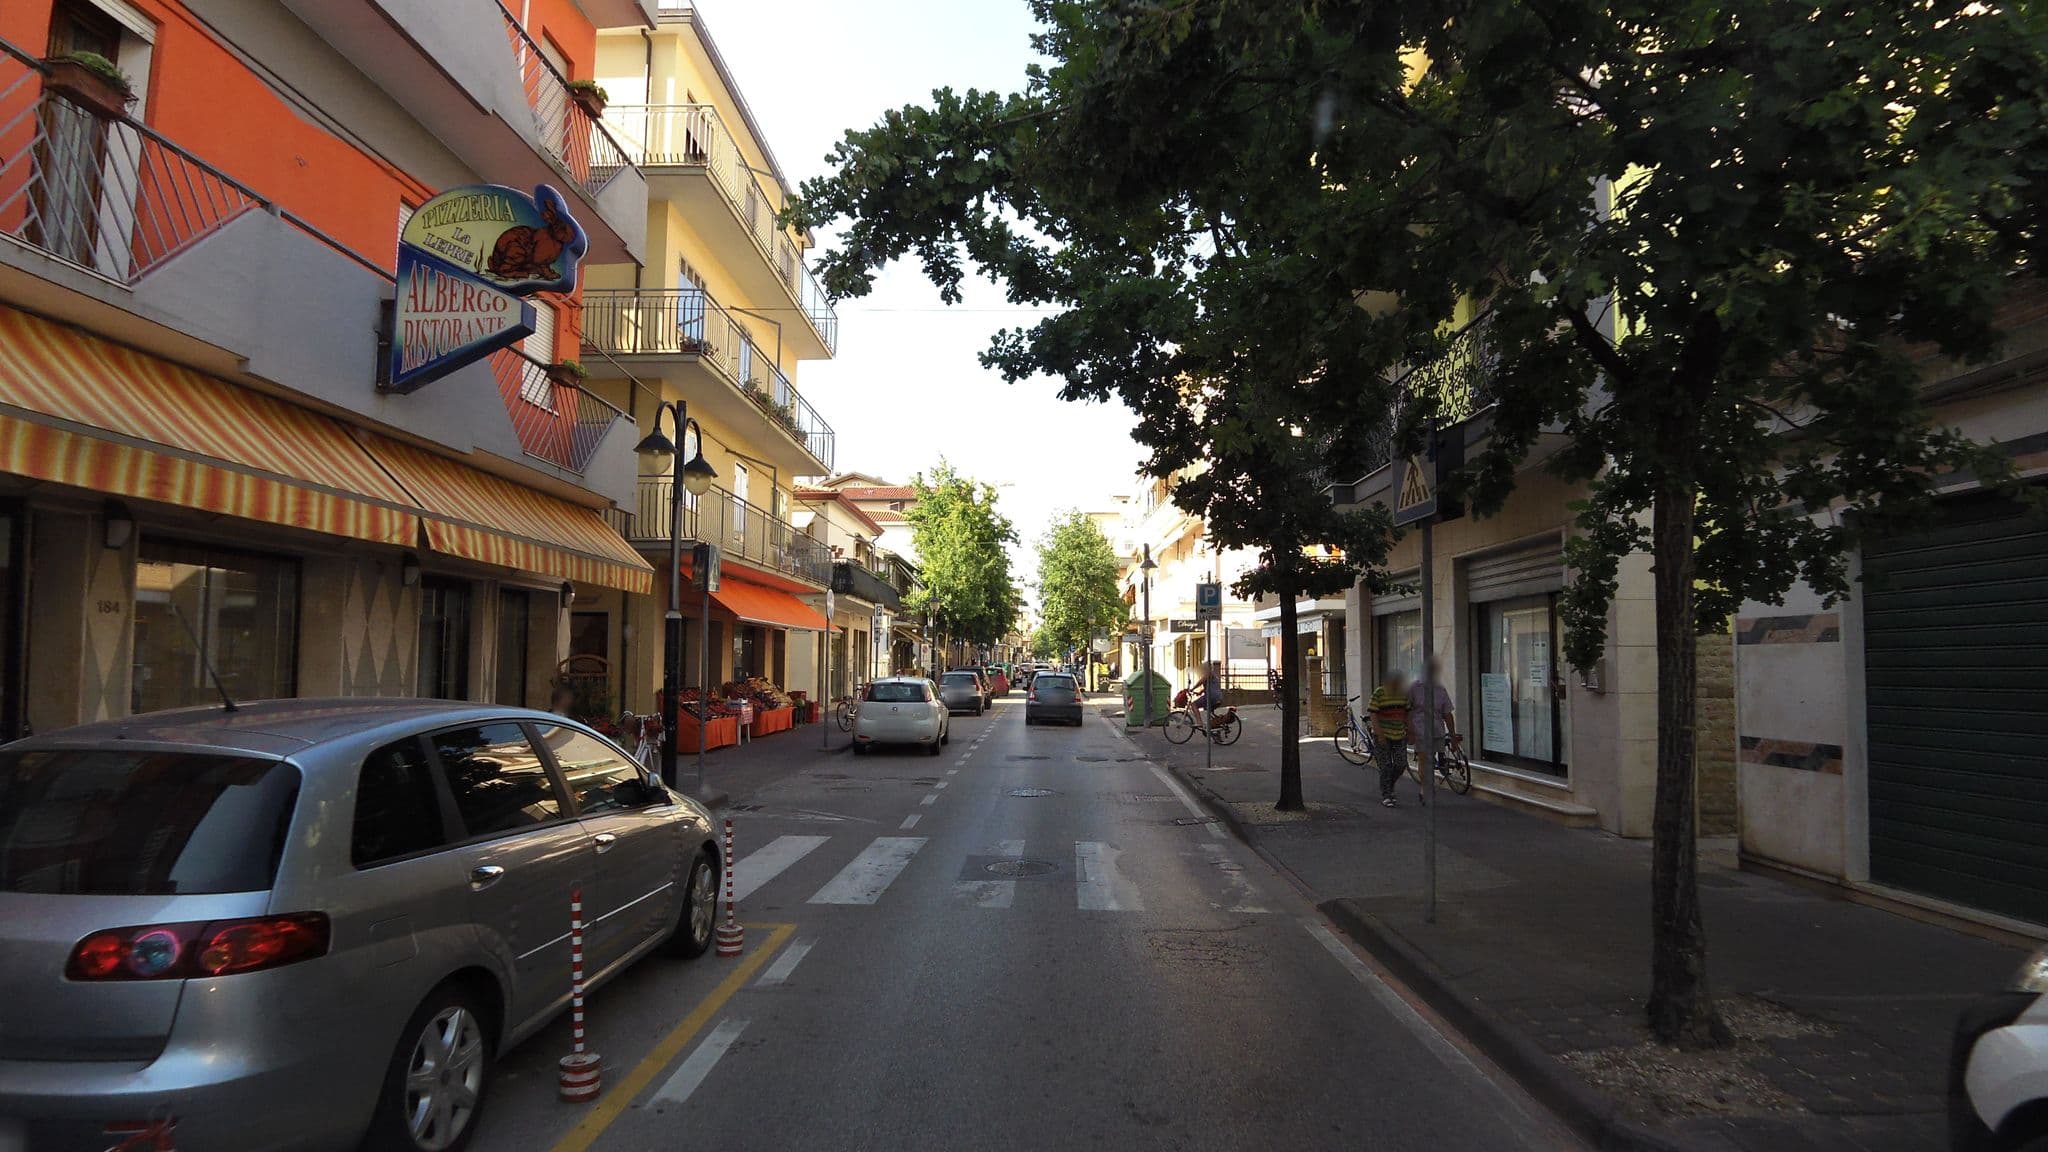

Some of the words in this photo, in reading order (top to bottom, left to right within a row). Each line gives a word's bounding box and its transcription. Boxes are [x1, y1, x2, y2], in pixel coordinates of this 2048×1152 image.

[422, 195, 516, 229] PIZZERIA
[423, 233, 475, 264] LEPRE
[451, 227, 471, 245] La
[405, 261, 507, 313] ALBERGO
[401, 317, 506, 373] RISTORANTE
[96, 600, 120, 614] 184
[1204, 587, 1216, 604] P
